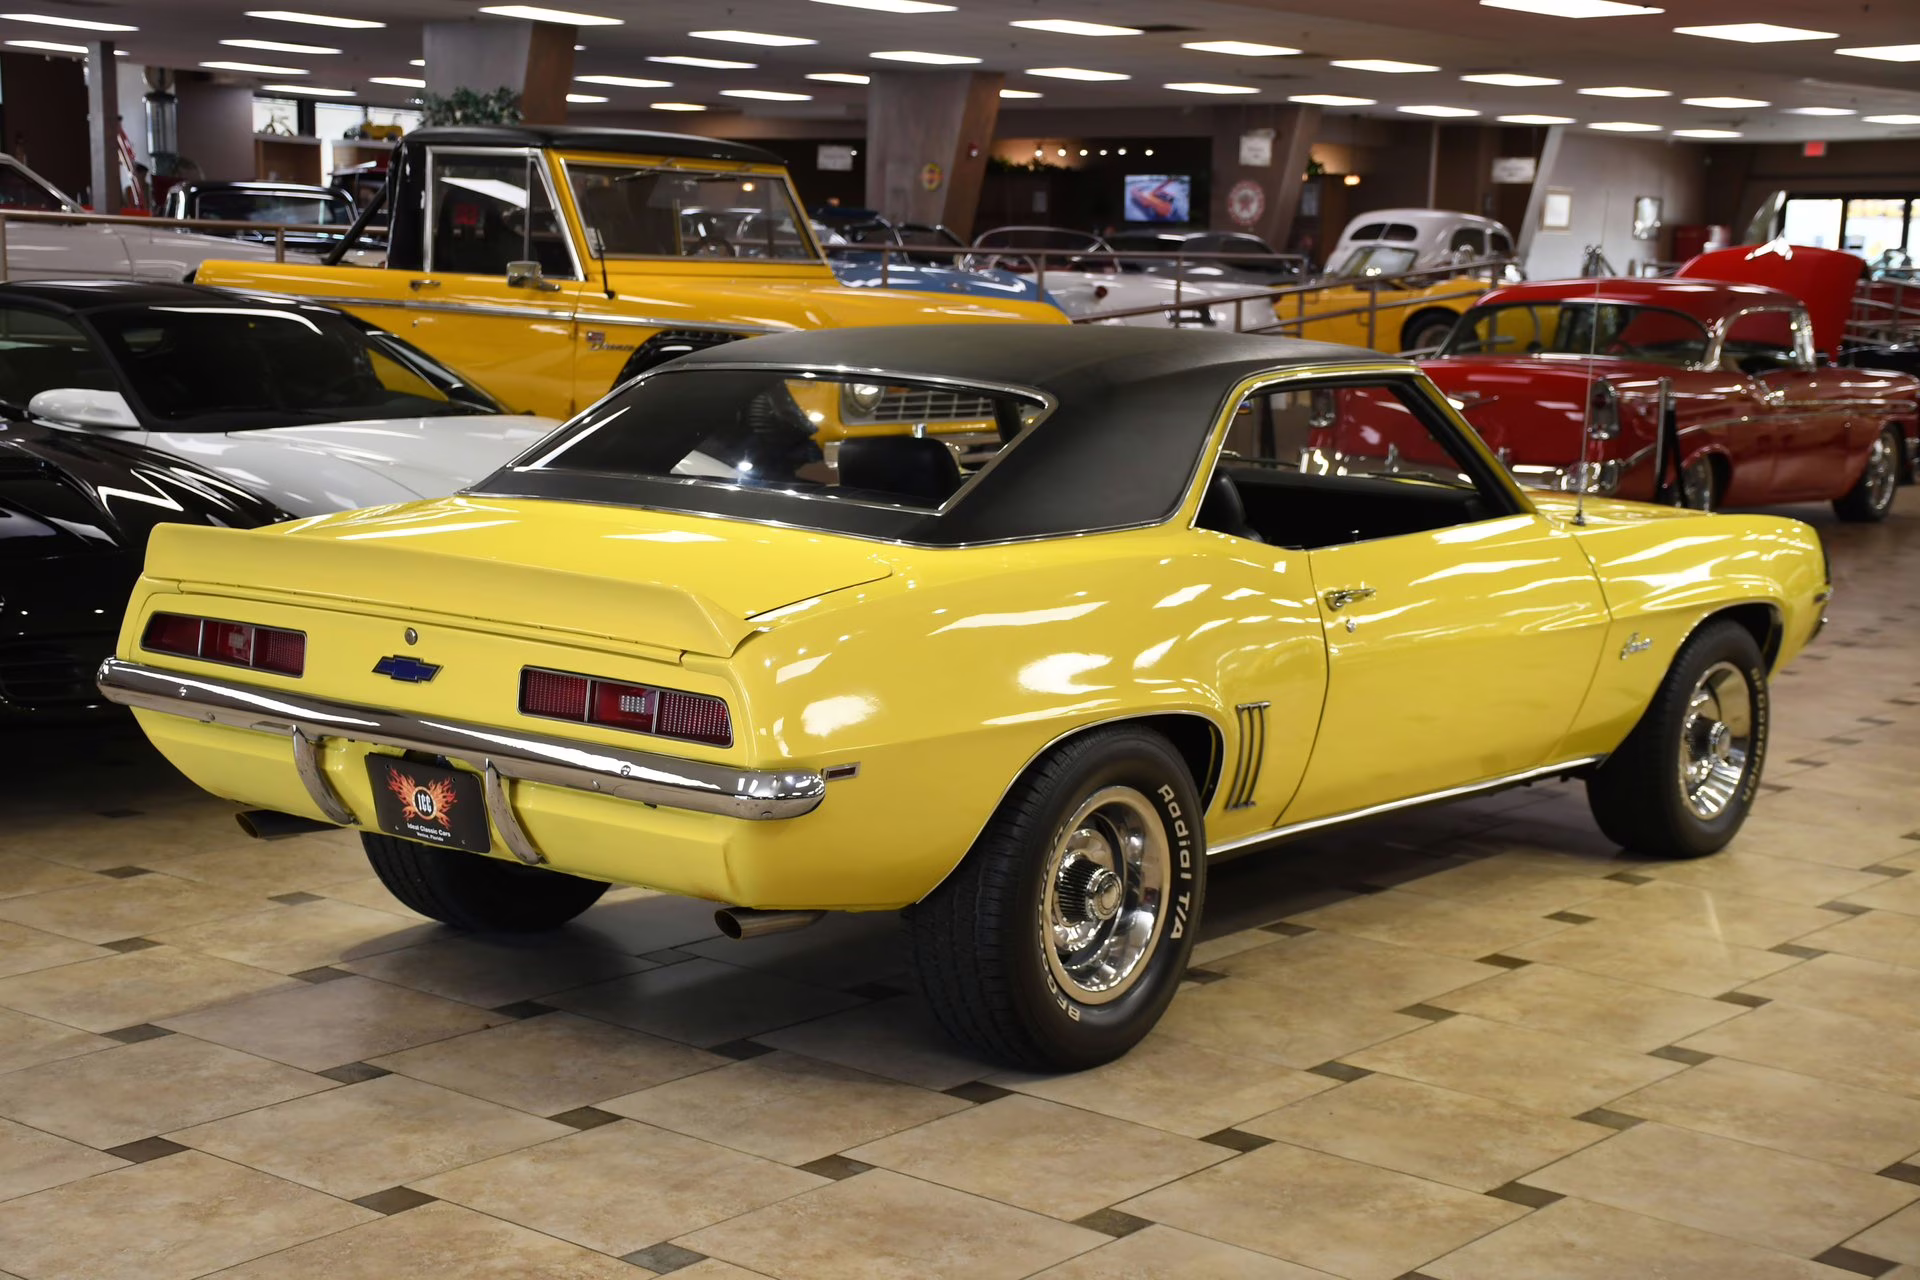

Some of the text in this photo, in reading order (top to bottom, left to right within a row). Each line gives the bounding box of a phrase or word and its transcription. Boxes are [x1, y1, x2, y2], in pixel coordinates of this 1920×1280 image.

[417, 794, 431, 812] ICC
[420, 825, 438, 834] Classic
[439, 829, 451, 837] Cars
[1157, 784, 1192, 939] Radial T/A
